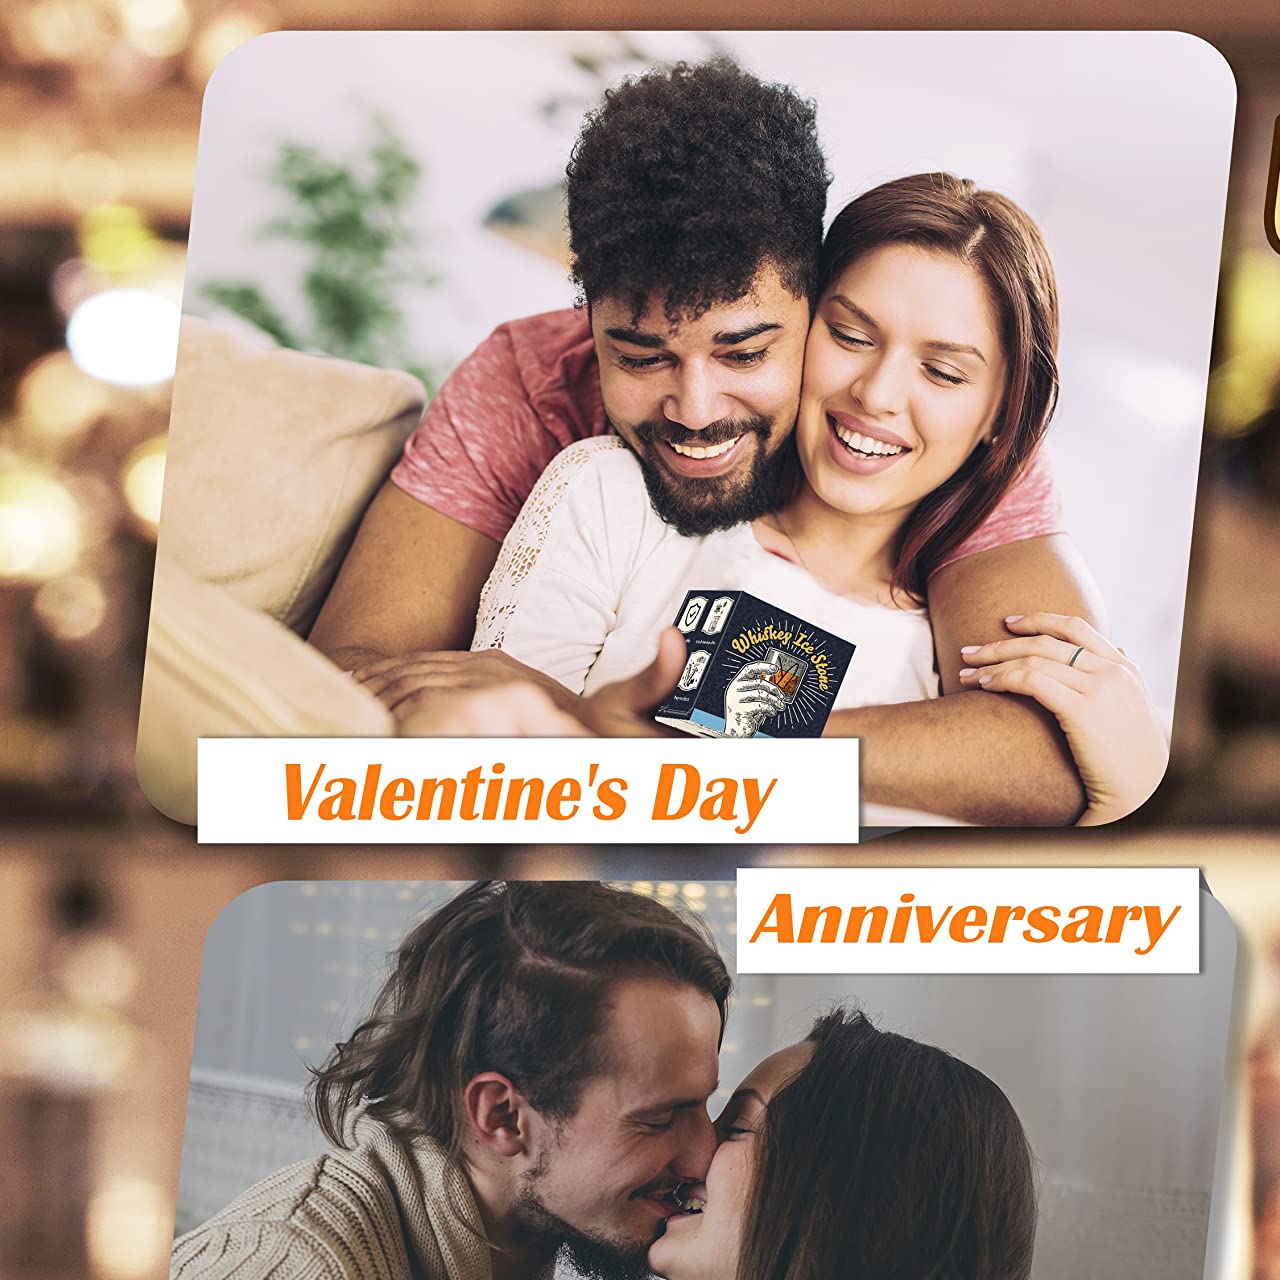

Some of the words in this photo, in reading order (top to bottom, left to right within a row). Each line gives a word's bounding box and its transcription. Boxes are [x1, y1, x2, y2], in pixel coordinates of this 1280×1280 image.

[731, 624, 793, 654] Whiskey
[793, 633, 814, 654] Ice
[811, 654, 829, 691] Stone
